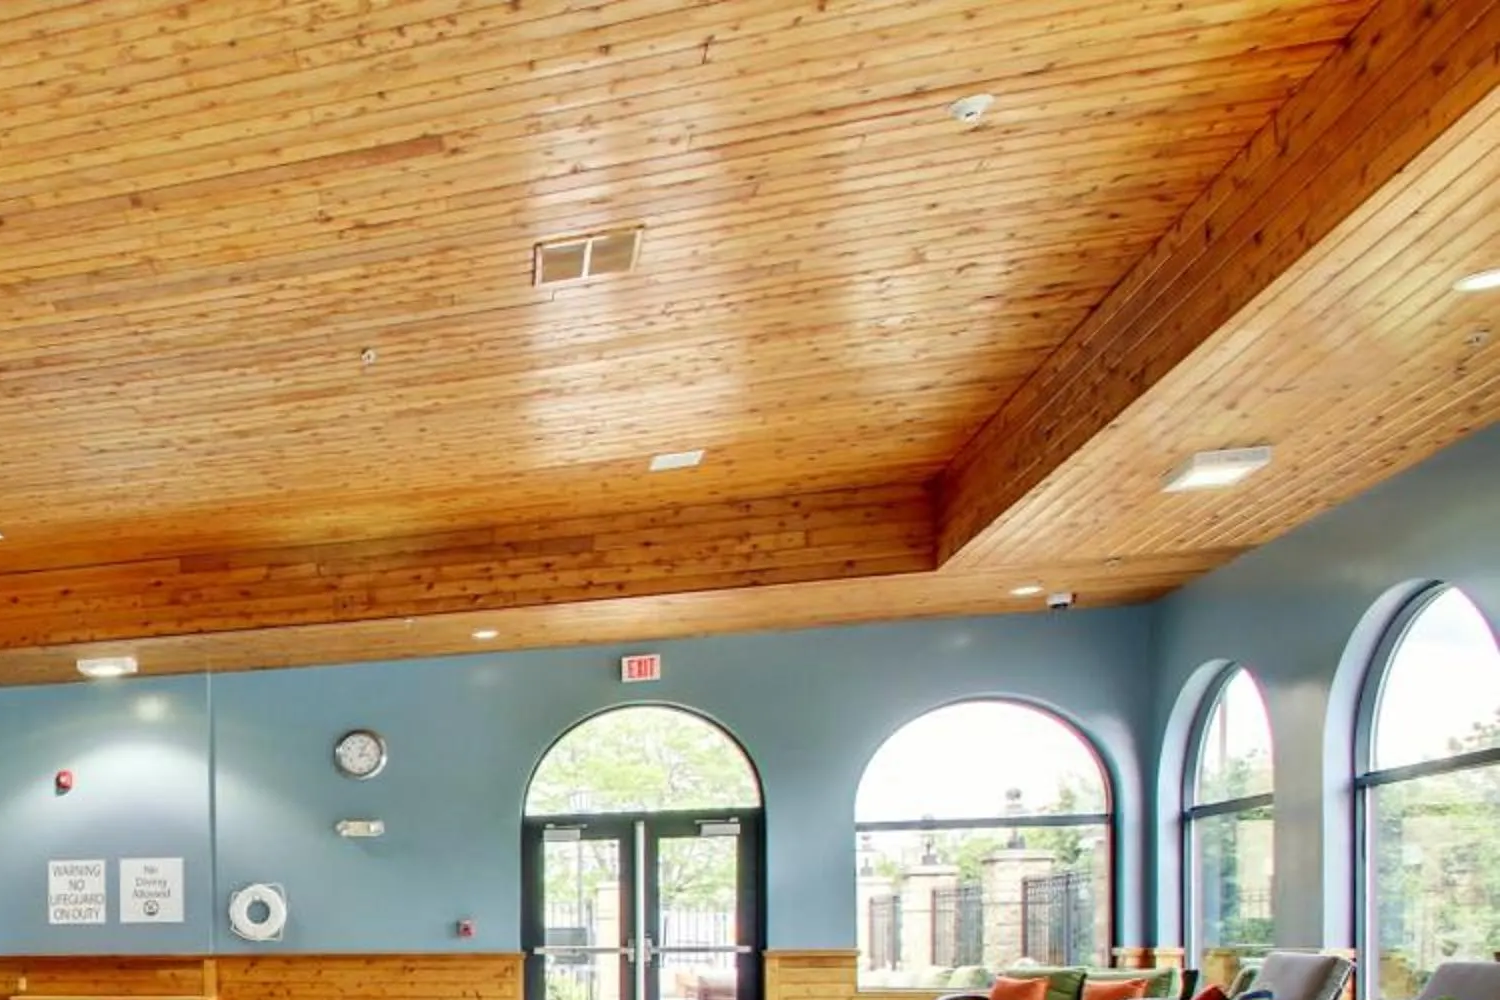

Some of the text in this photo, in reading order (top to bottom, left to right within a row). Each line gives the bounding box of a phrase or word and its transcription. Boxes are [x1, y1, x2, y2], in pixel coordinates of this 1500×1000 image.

[627, 656, 656, 679] EXIT
[52, 863, 102, 878] WARNING
[68, 879, 86, 891] NO
[53, 907, 99, 920] ON DUTY
